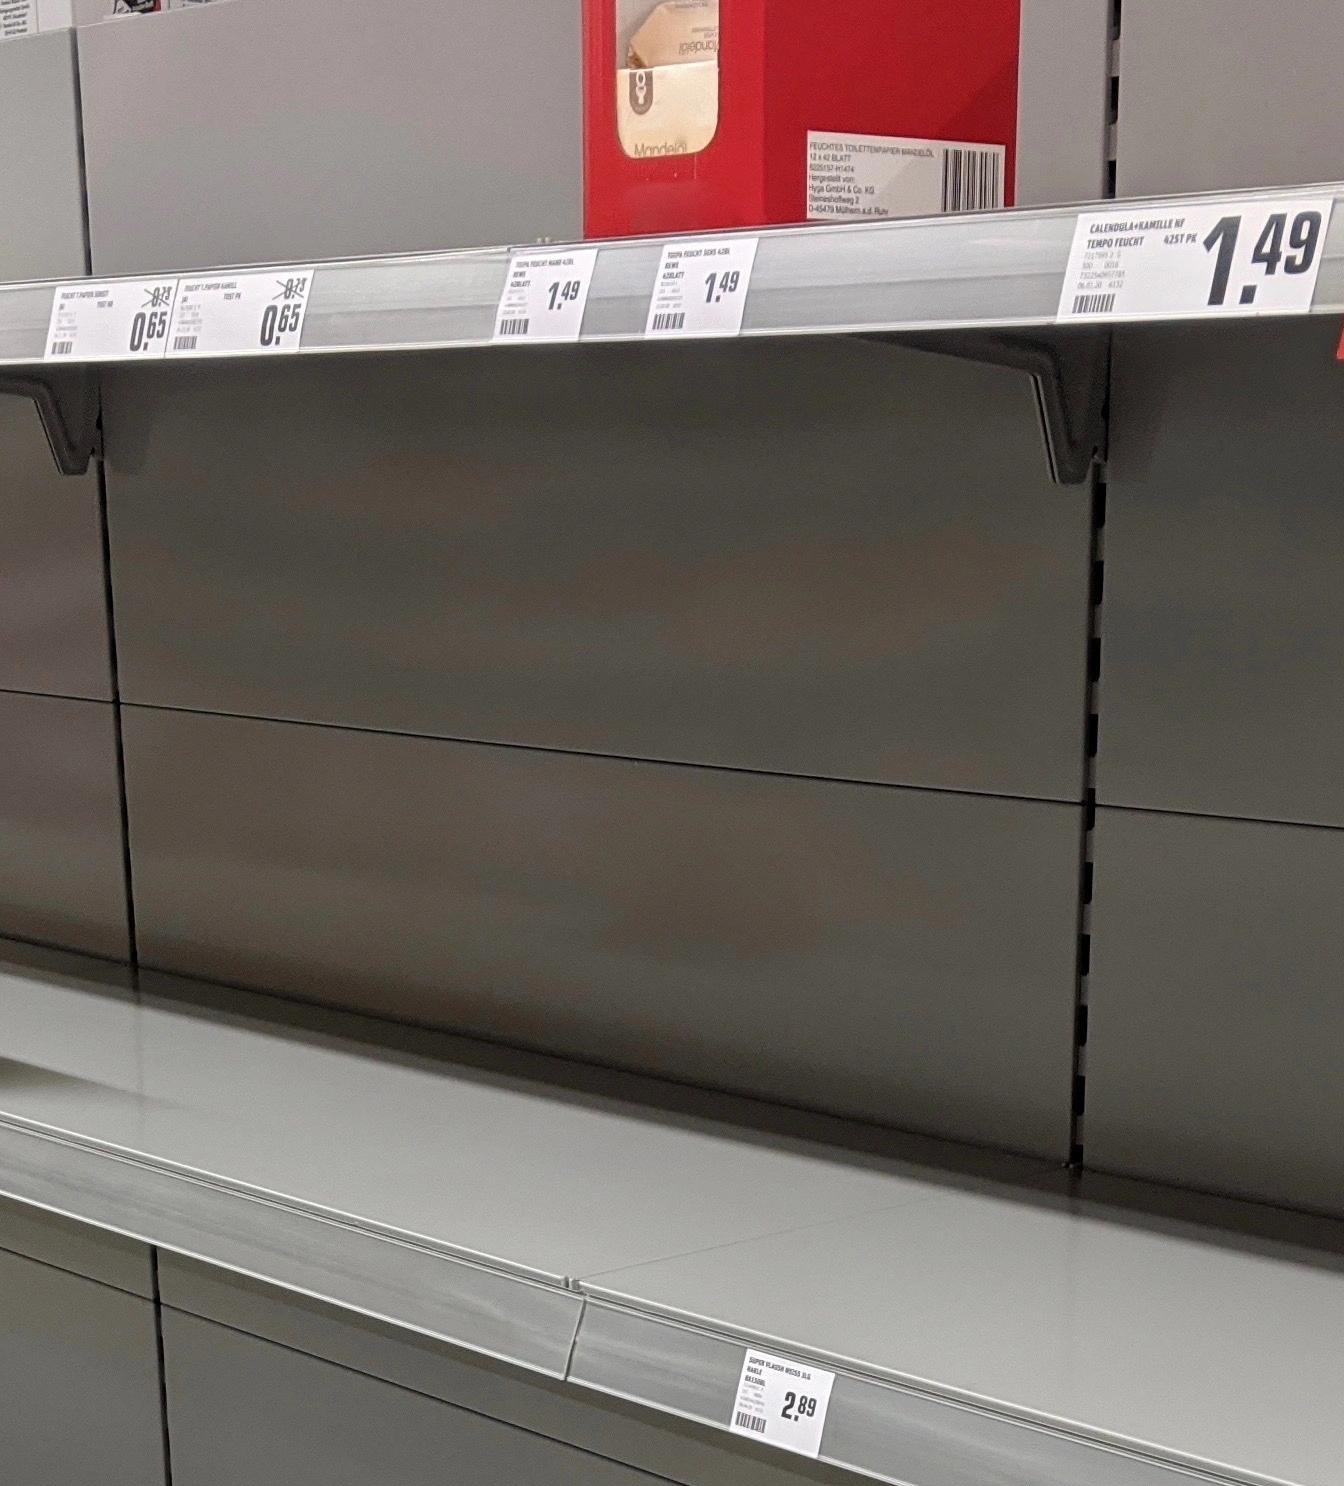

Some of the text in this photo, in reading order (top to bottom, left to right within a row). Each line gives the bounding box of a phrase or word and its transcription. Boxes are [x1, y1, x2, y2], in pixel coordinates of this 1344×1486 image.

[810, 142, 844, 152] FEUCHTES
[845, 144, 900, 155] TOILETTENPAPIER
[809, 173, 841, 183] Hergestellt
[825, 186, 846, 194] GmbH
[847, 186, 852, 194] &
[864, 186, 875, 194] KG
[1090, 218, 1186, 234] CALENDULA+KAMILLE NF
[1087, 233, 1197, 249] TEMPO FEUCHT 42ST PK
[1203, 210, 1322, 306] 1.49
[548, 280, 581, 310] 1.49
[705, 270, 740, 303] 1.49
[129, 311, 168, 352] 0.65
[260, 303, 302, 347] 0.65
[749, 1356, 765, 1367] SUPER
[781, 1391, 817, 1422] 2.89
